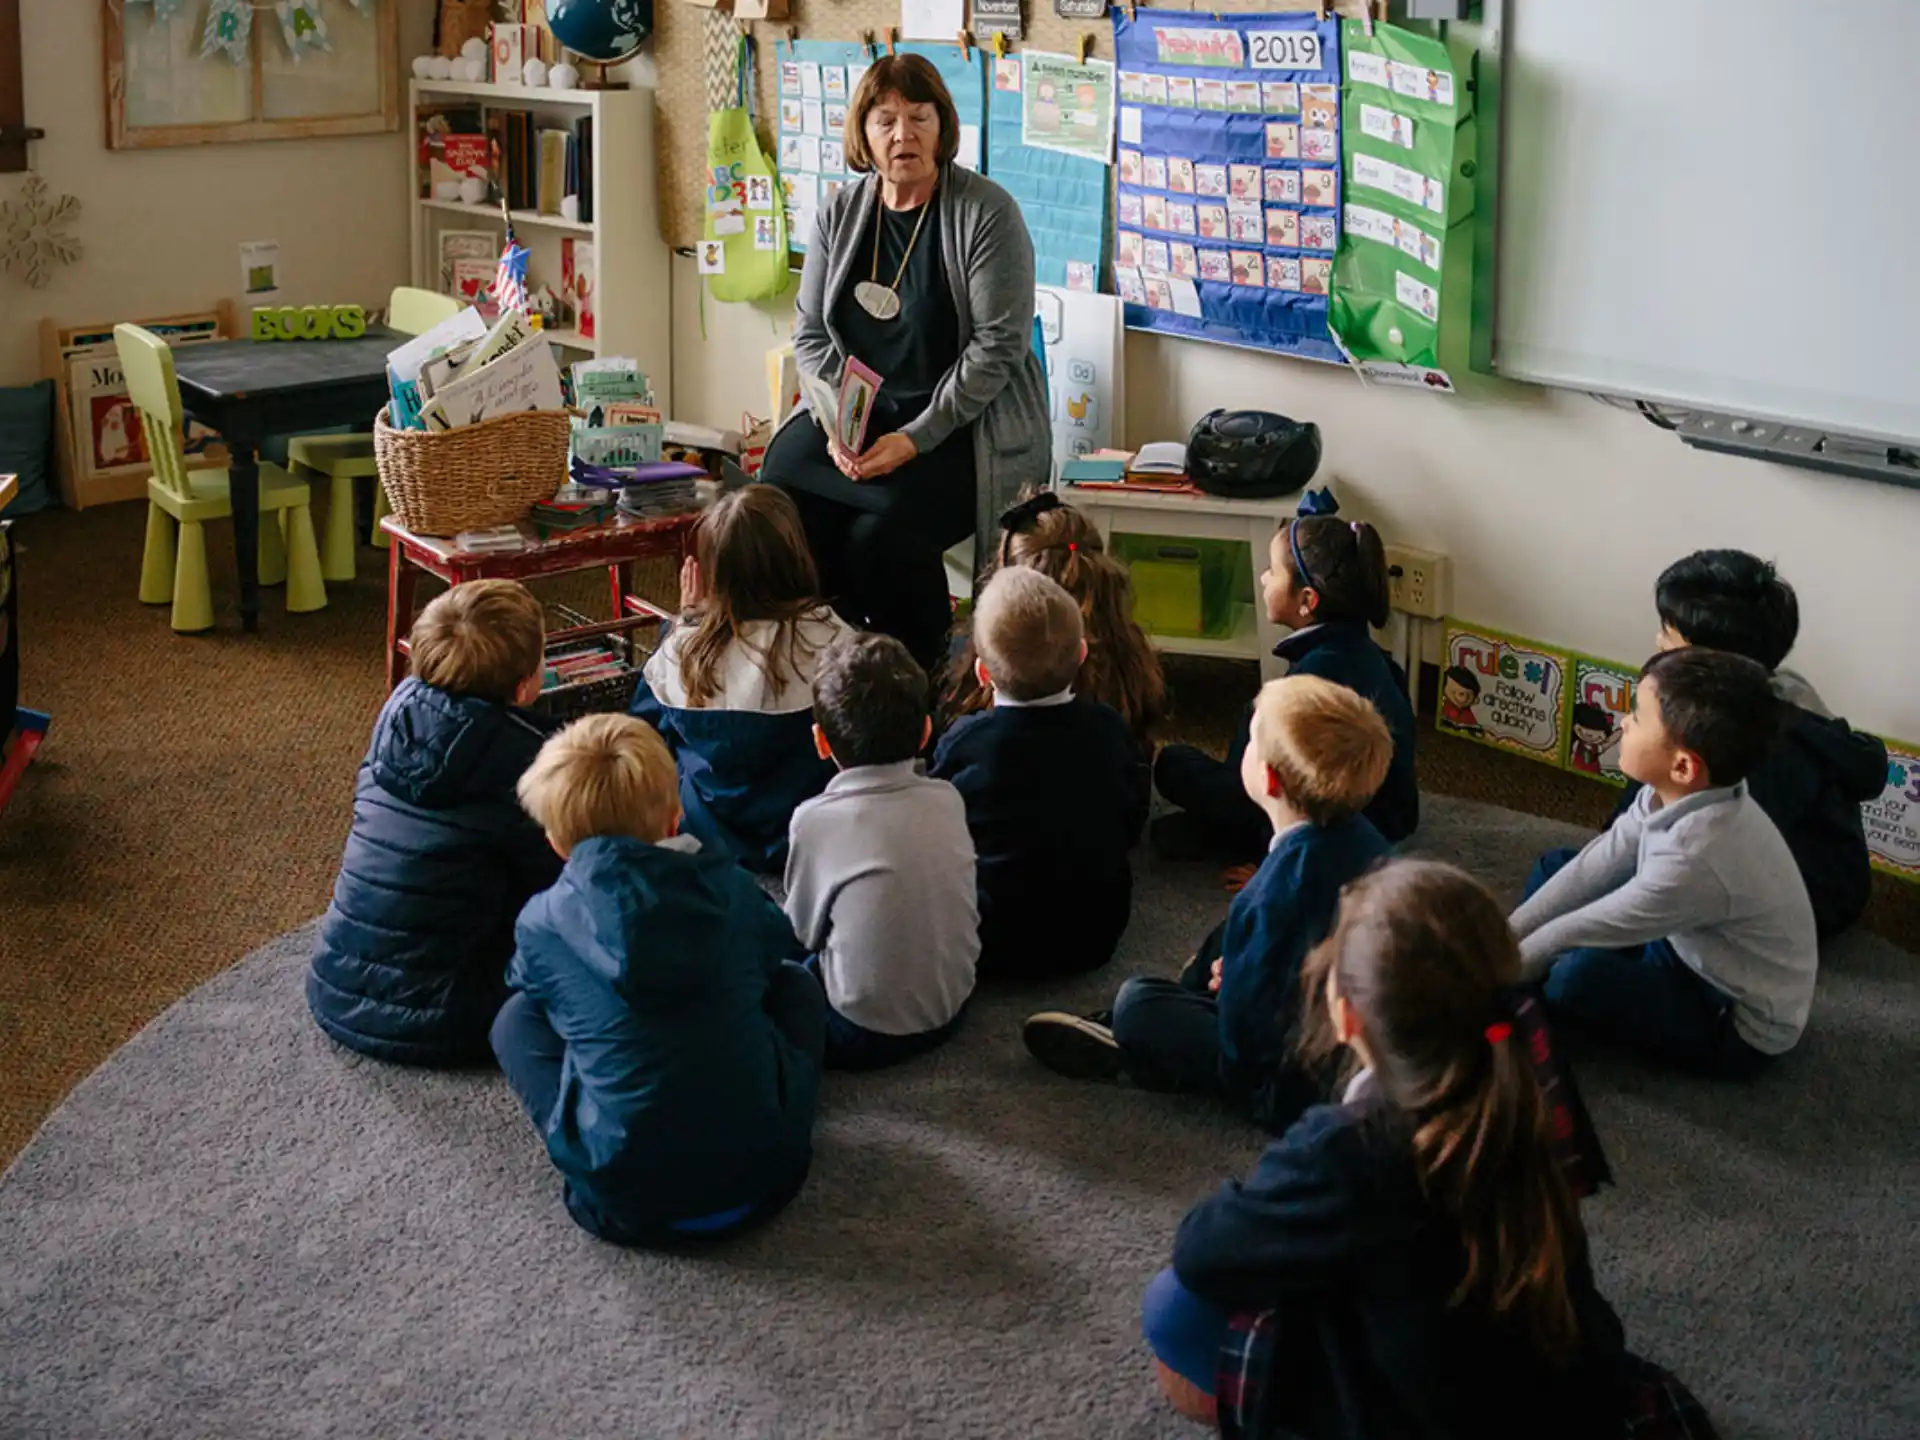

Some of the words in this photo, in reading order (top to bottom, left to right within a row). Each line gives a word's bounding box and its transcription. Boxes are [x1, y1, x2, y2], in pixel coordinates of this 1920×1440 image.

[218, 11, 237, 41] R
[293, 7, 317, 37] A
[1252, 35, 1316, 64] 2019
[1323, 135, 1332, 149] 2
[1247, 169, 1257, 183] 7
[1320, 174, 1332, 190] 9
[253, 304, 366, 341] BOOKS
[1074, 364, 1089, 380] Dd
[1458, 643, 1520, 680] rule
[1523, 660, 1554, 696] #1
[1495, 679, 1536, 703] Follow
[1586, 679, 1637, 717] rul
[1483, 692, 1547, 723] directions
[1491, 710, 1536, 736] quickly
[1905, 825, 1918, 839] to
